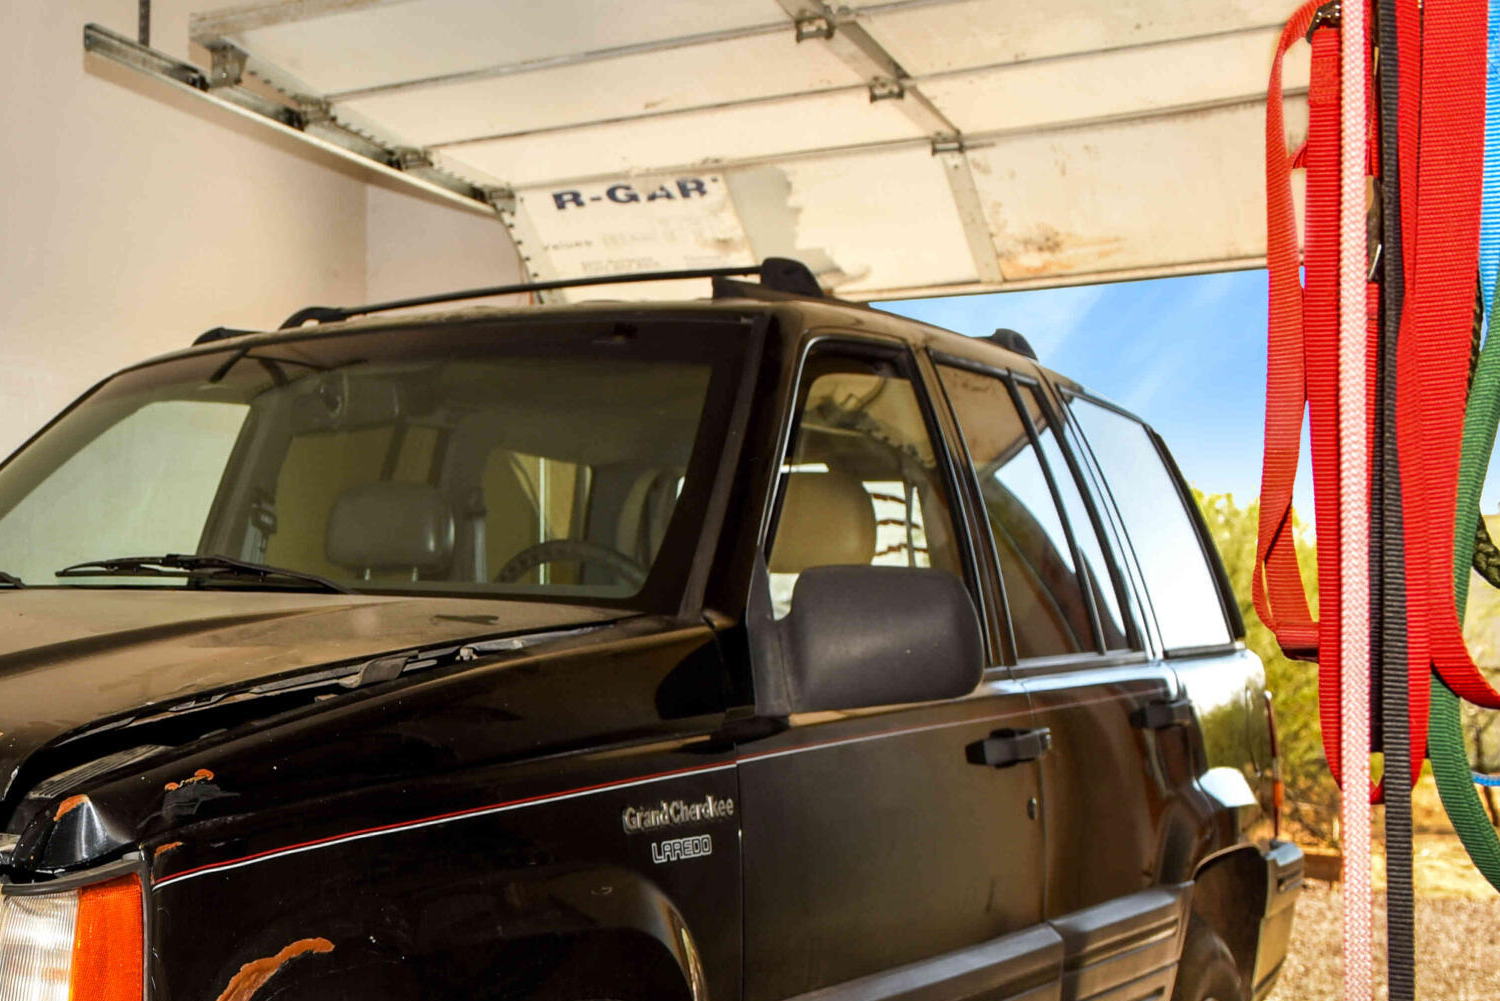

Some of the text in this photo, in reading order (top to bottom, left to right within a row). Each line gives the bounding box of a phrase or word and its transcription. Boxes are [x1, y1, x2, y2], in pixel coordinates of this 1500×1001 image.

[624, 795, 734, 831] Grand Cherokee
[652, 835, 712, 863] LAREDO
